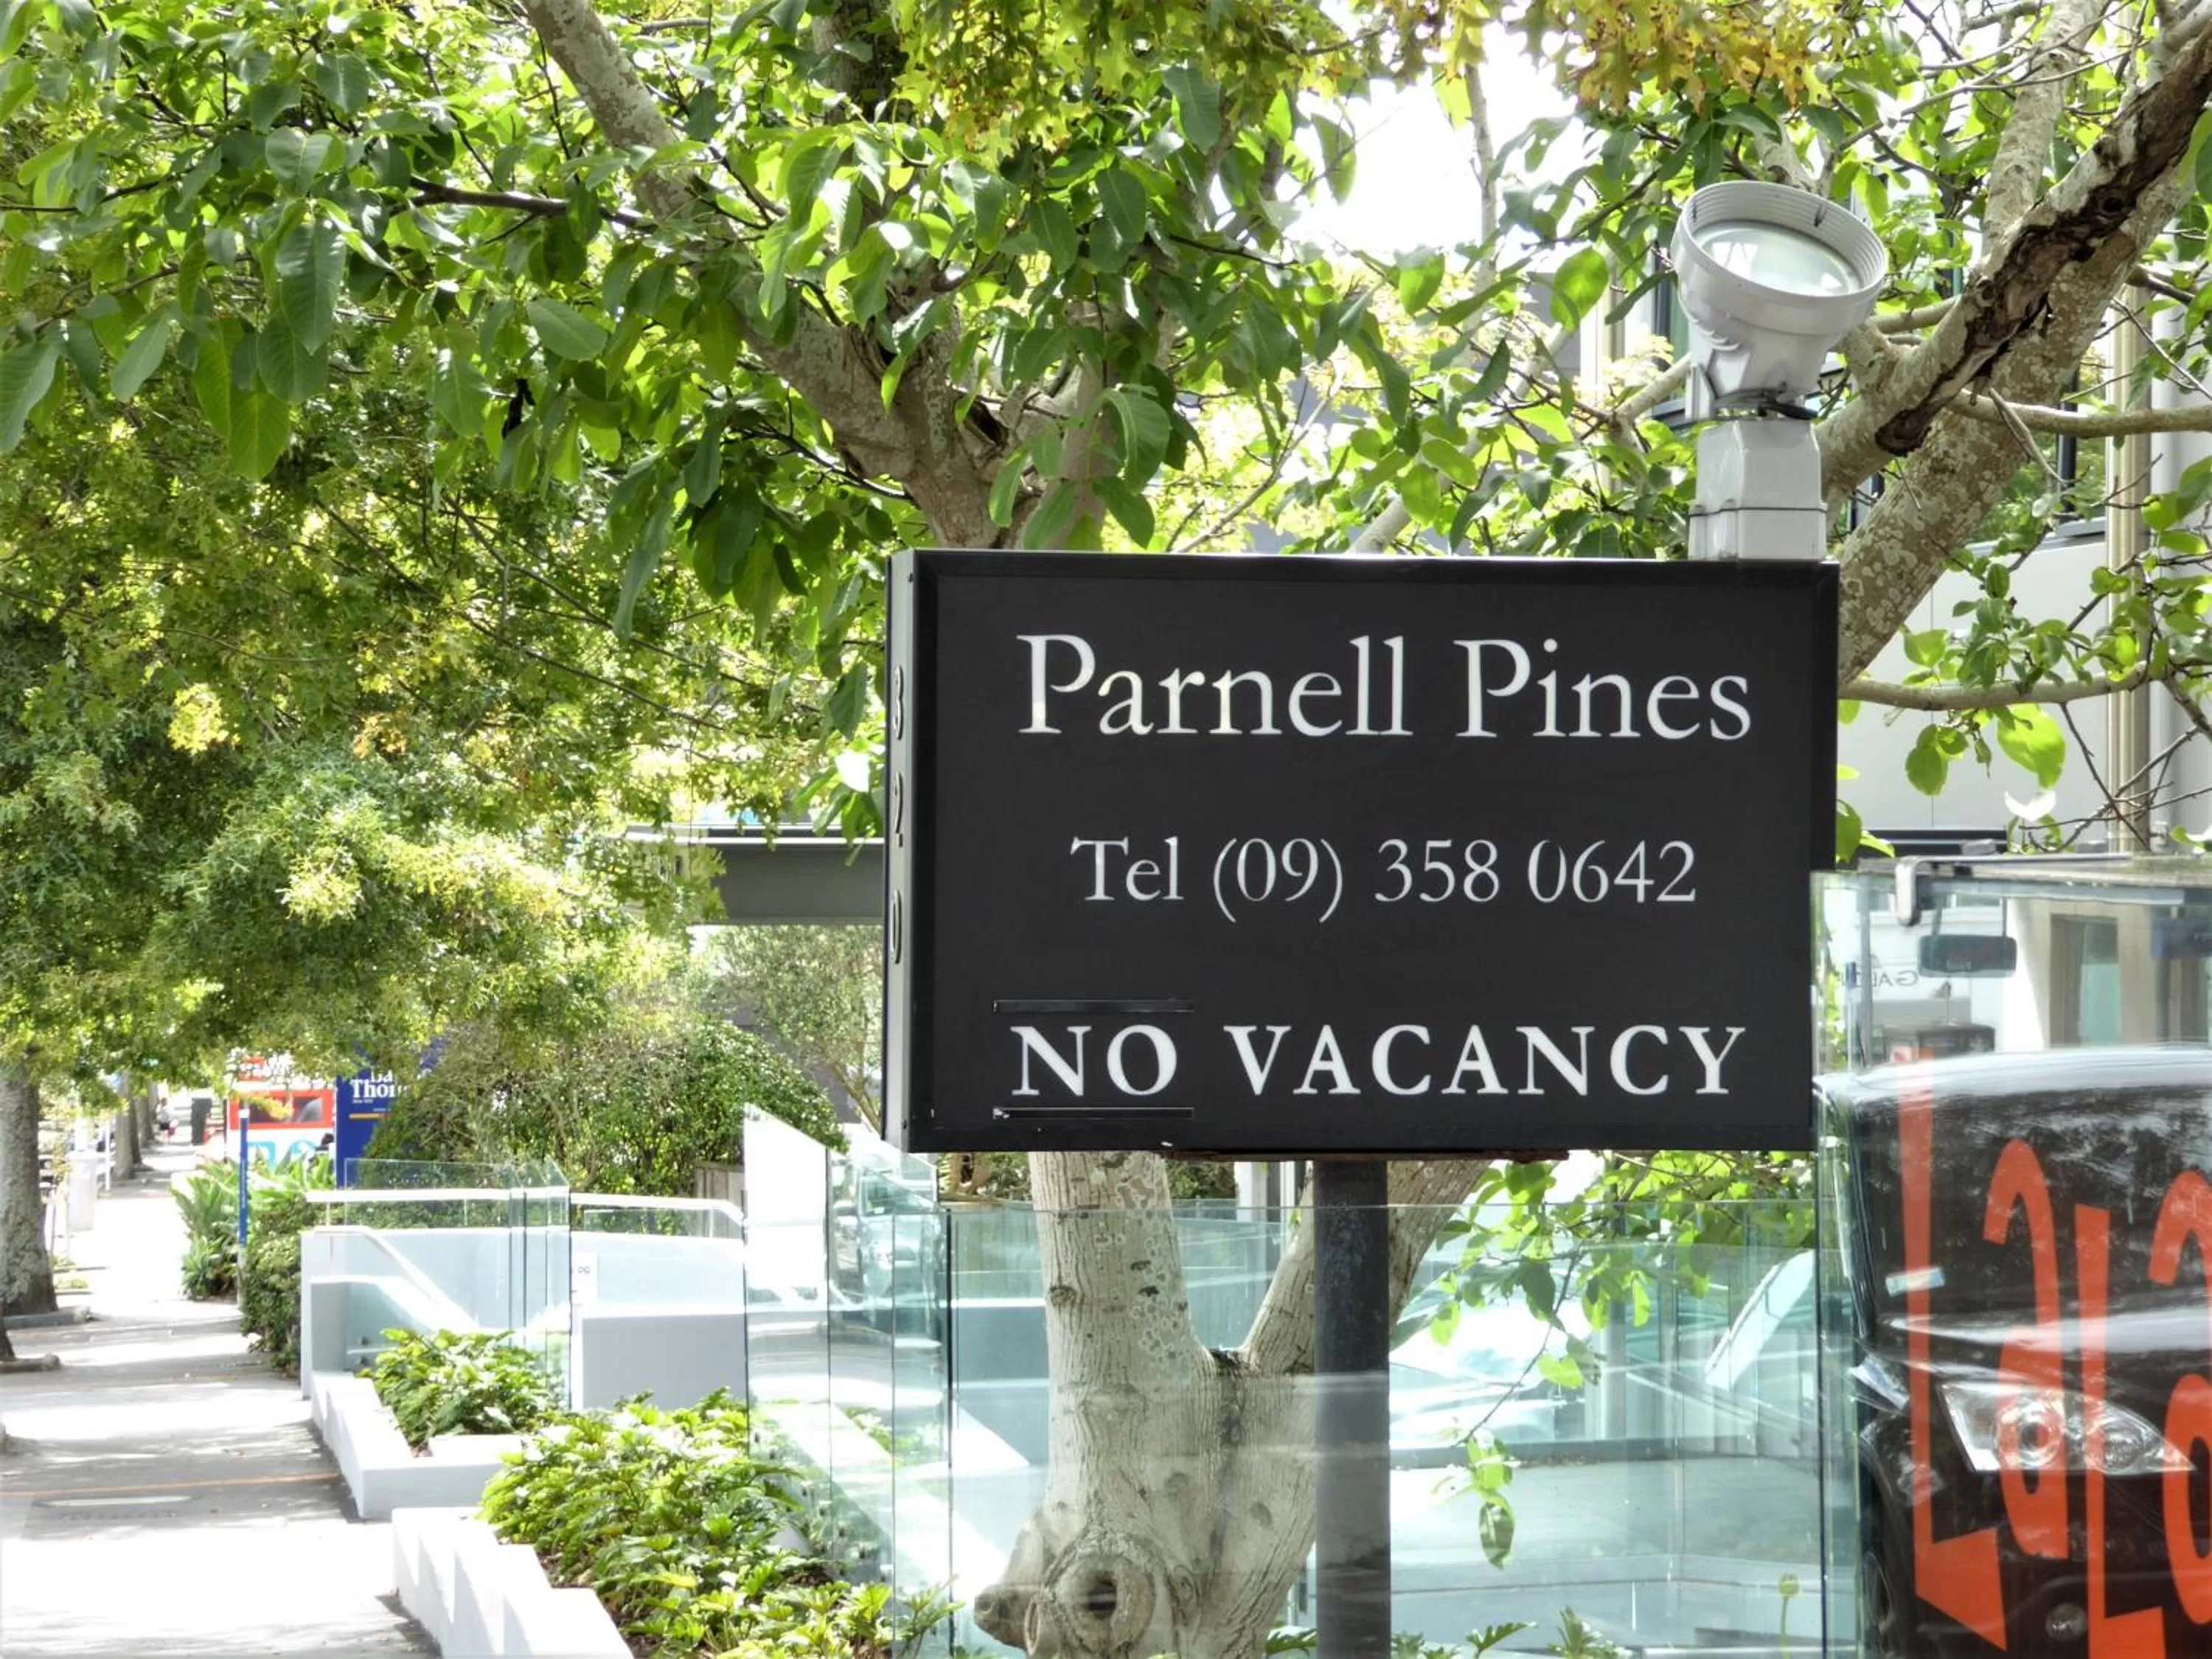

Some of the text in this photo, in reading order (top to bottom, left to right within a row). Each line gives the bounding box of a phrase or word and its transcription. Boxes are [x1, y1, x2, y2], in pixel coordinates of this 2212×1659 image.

[1016, 634, 1750, 740] Parnell Pines
[1070, 836, 1696, 922] Tel (09) 358 0642
[1010, 1024, 1746, 1096] NO VACANCY
